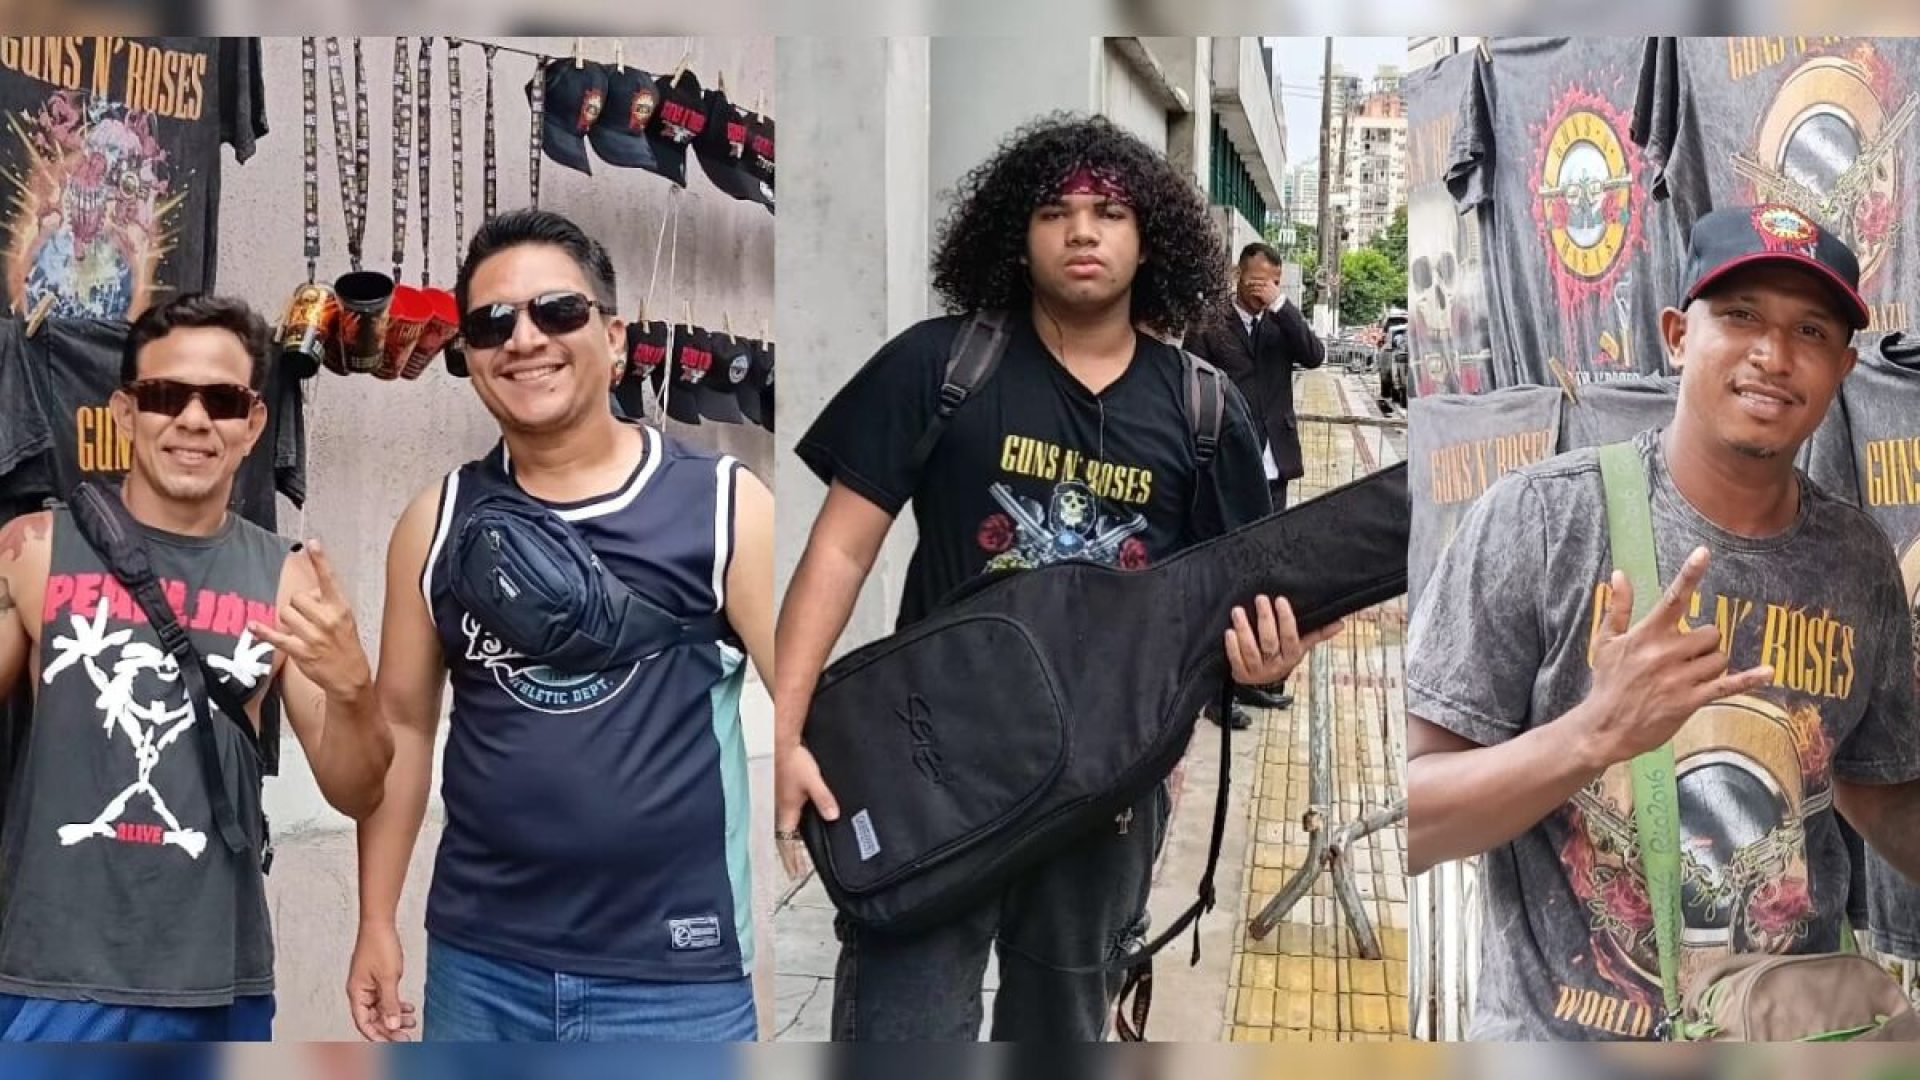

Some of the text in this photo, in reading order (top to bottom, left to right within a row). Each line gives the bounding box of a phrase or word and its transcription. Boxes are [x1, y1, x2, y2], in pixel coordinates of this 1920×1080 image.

[126, 41, 207, 120] ROSES
[1001, 434, 1059, 480] GUNS
[1086, 459, 1152, 504] ROSES
[43, 573, 188, 627] PEAL
[1761, 603, 1855, 699] ROSES
[573, 677, 614, 702] DEPT.
[1554, 984, 1652, 1037] WORLD
